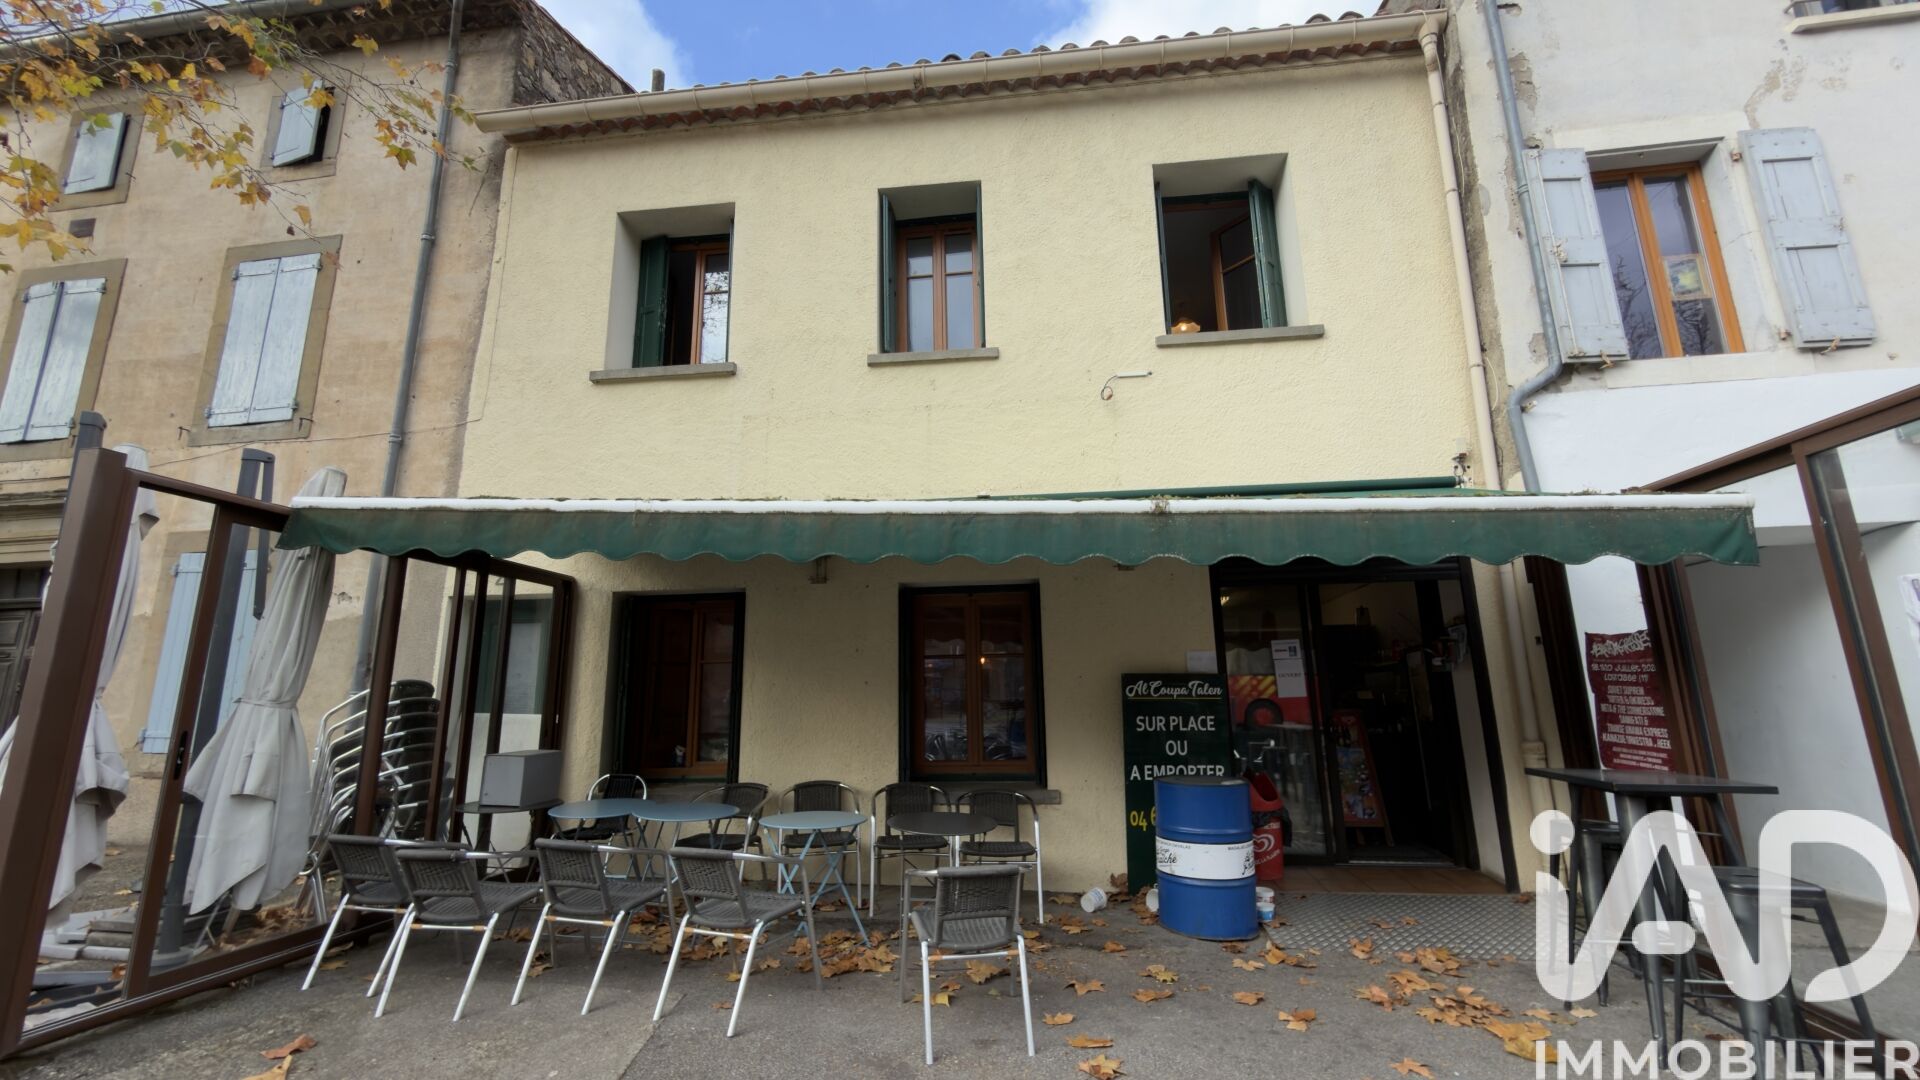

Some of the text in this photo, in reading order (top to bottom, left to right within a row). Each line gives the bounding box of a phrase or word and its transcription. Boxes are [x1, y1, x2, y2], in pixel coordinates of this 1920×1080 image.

[1125, 681, 1222, 699] Al Coupa Talen
[1136, 715, 1216, 732] SUR PLACE
[1165, 740, 1188, 755] OU
[1130, 765, 1141, 780] A
[1130, 810, 1148, 831] 04
